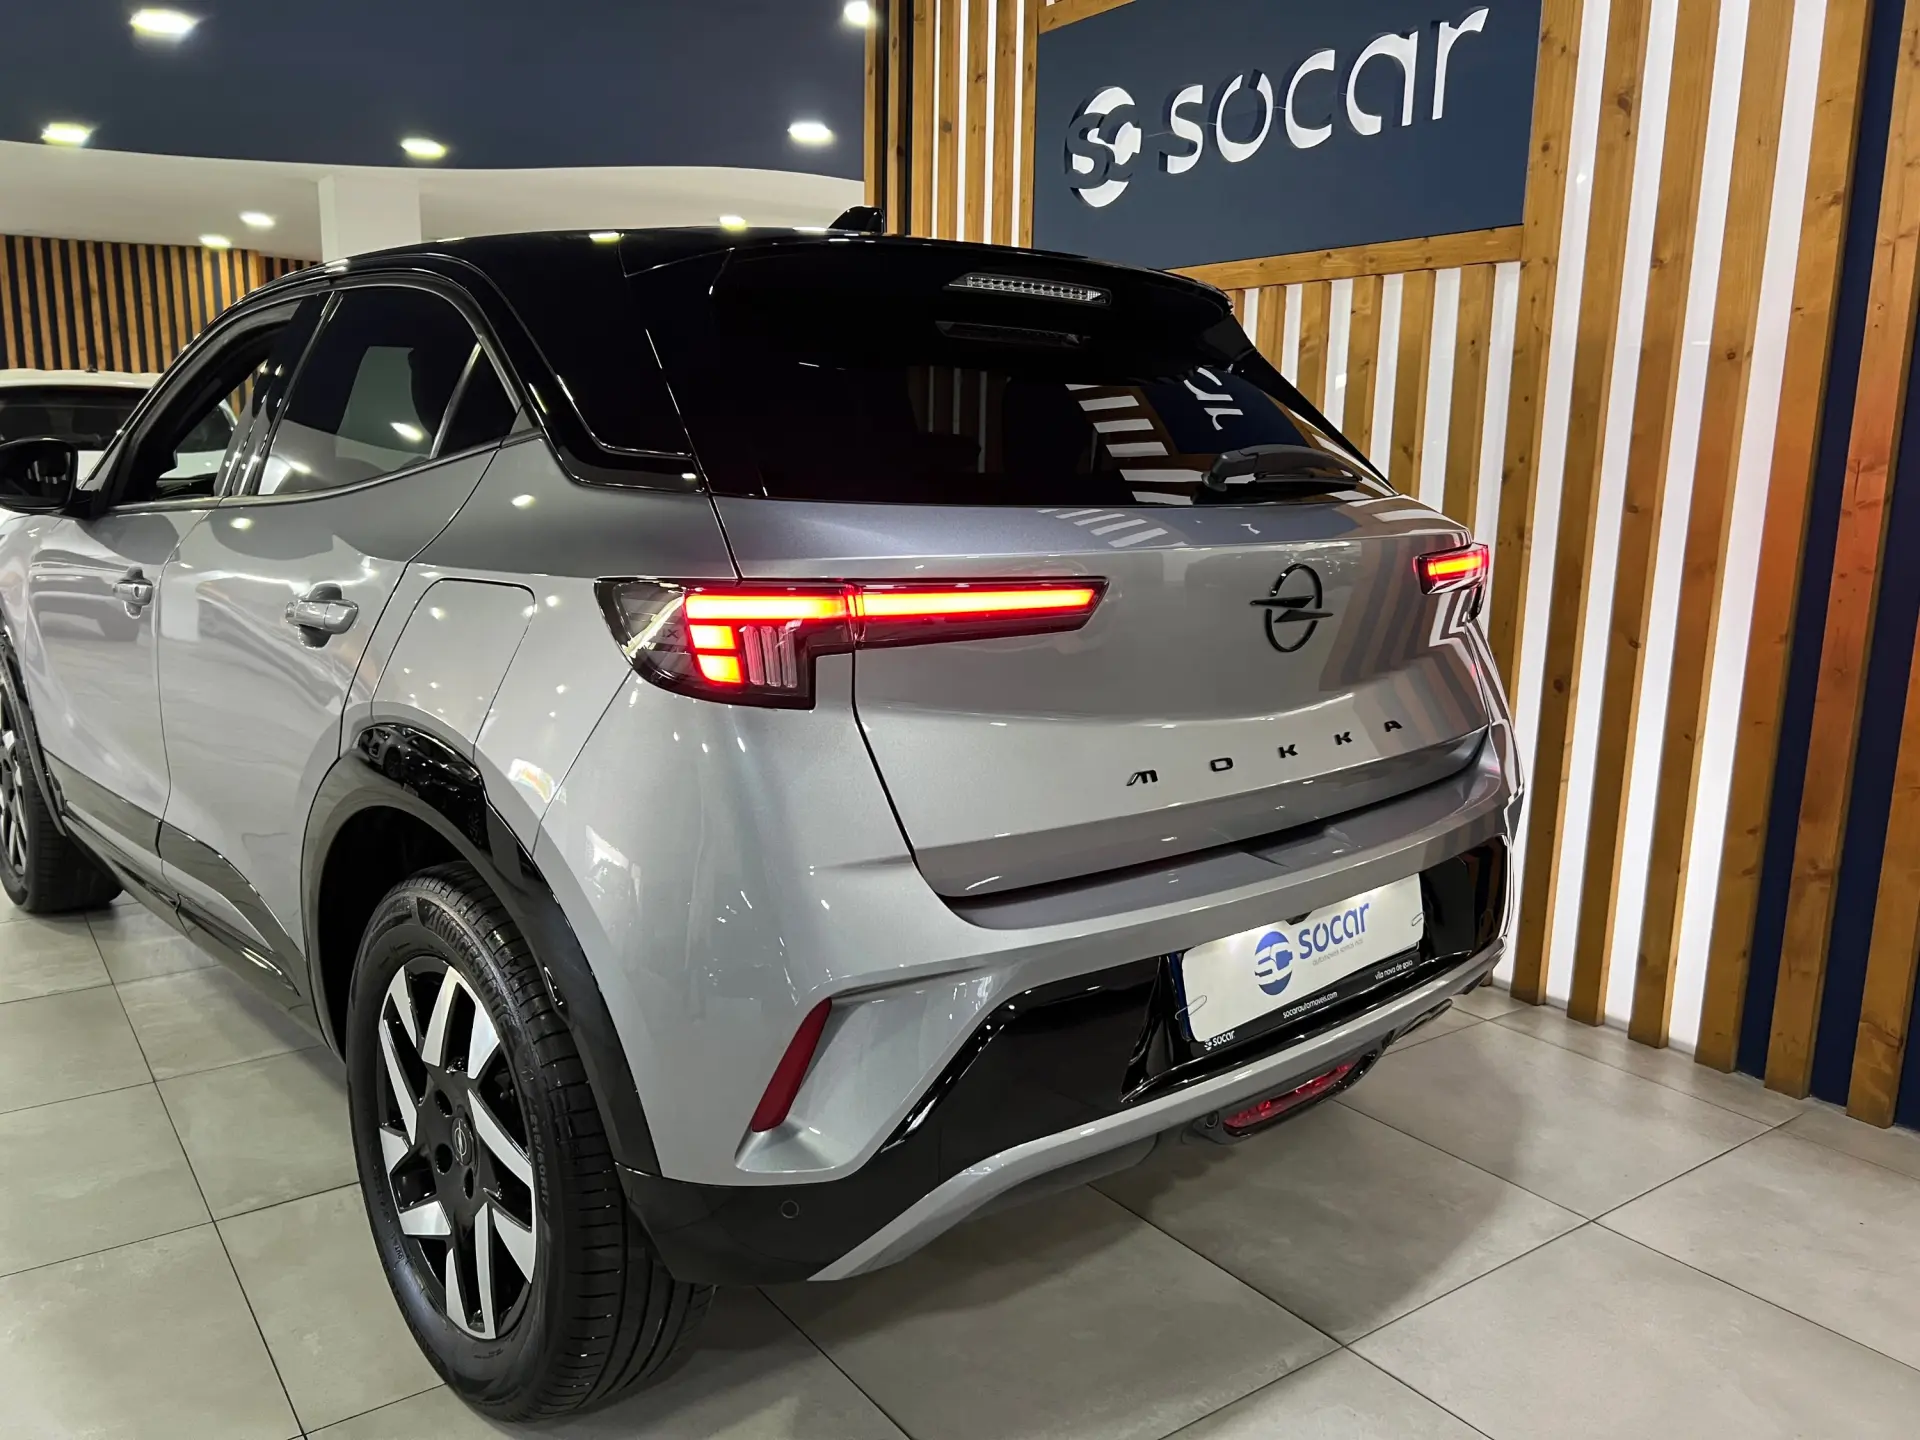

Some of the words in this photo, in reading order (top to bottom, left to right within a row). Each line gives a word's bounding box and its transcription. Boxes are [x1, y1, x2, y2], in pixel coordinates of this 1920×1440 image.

[1158, 6, 1489, 175] socar
[1126, 720, 1403, 787] MOKKA
[1298, 903, 1370, 960] socar
[1213, 1030, 1235, 1046] socar
